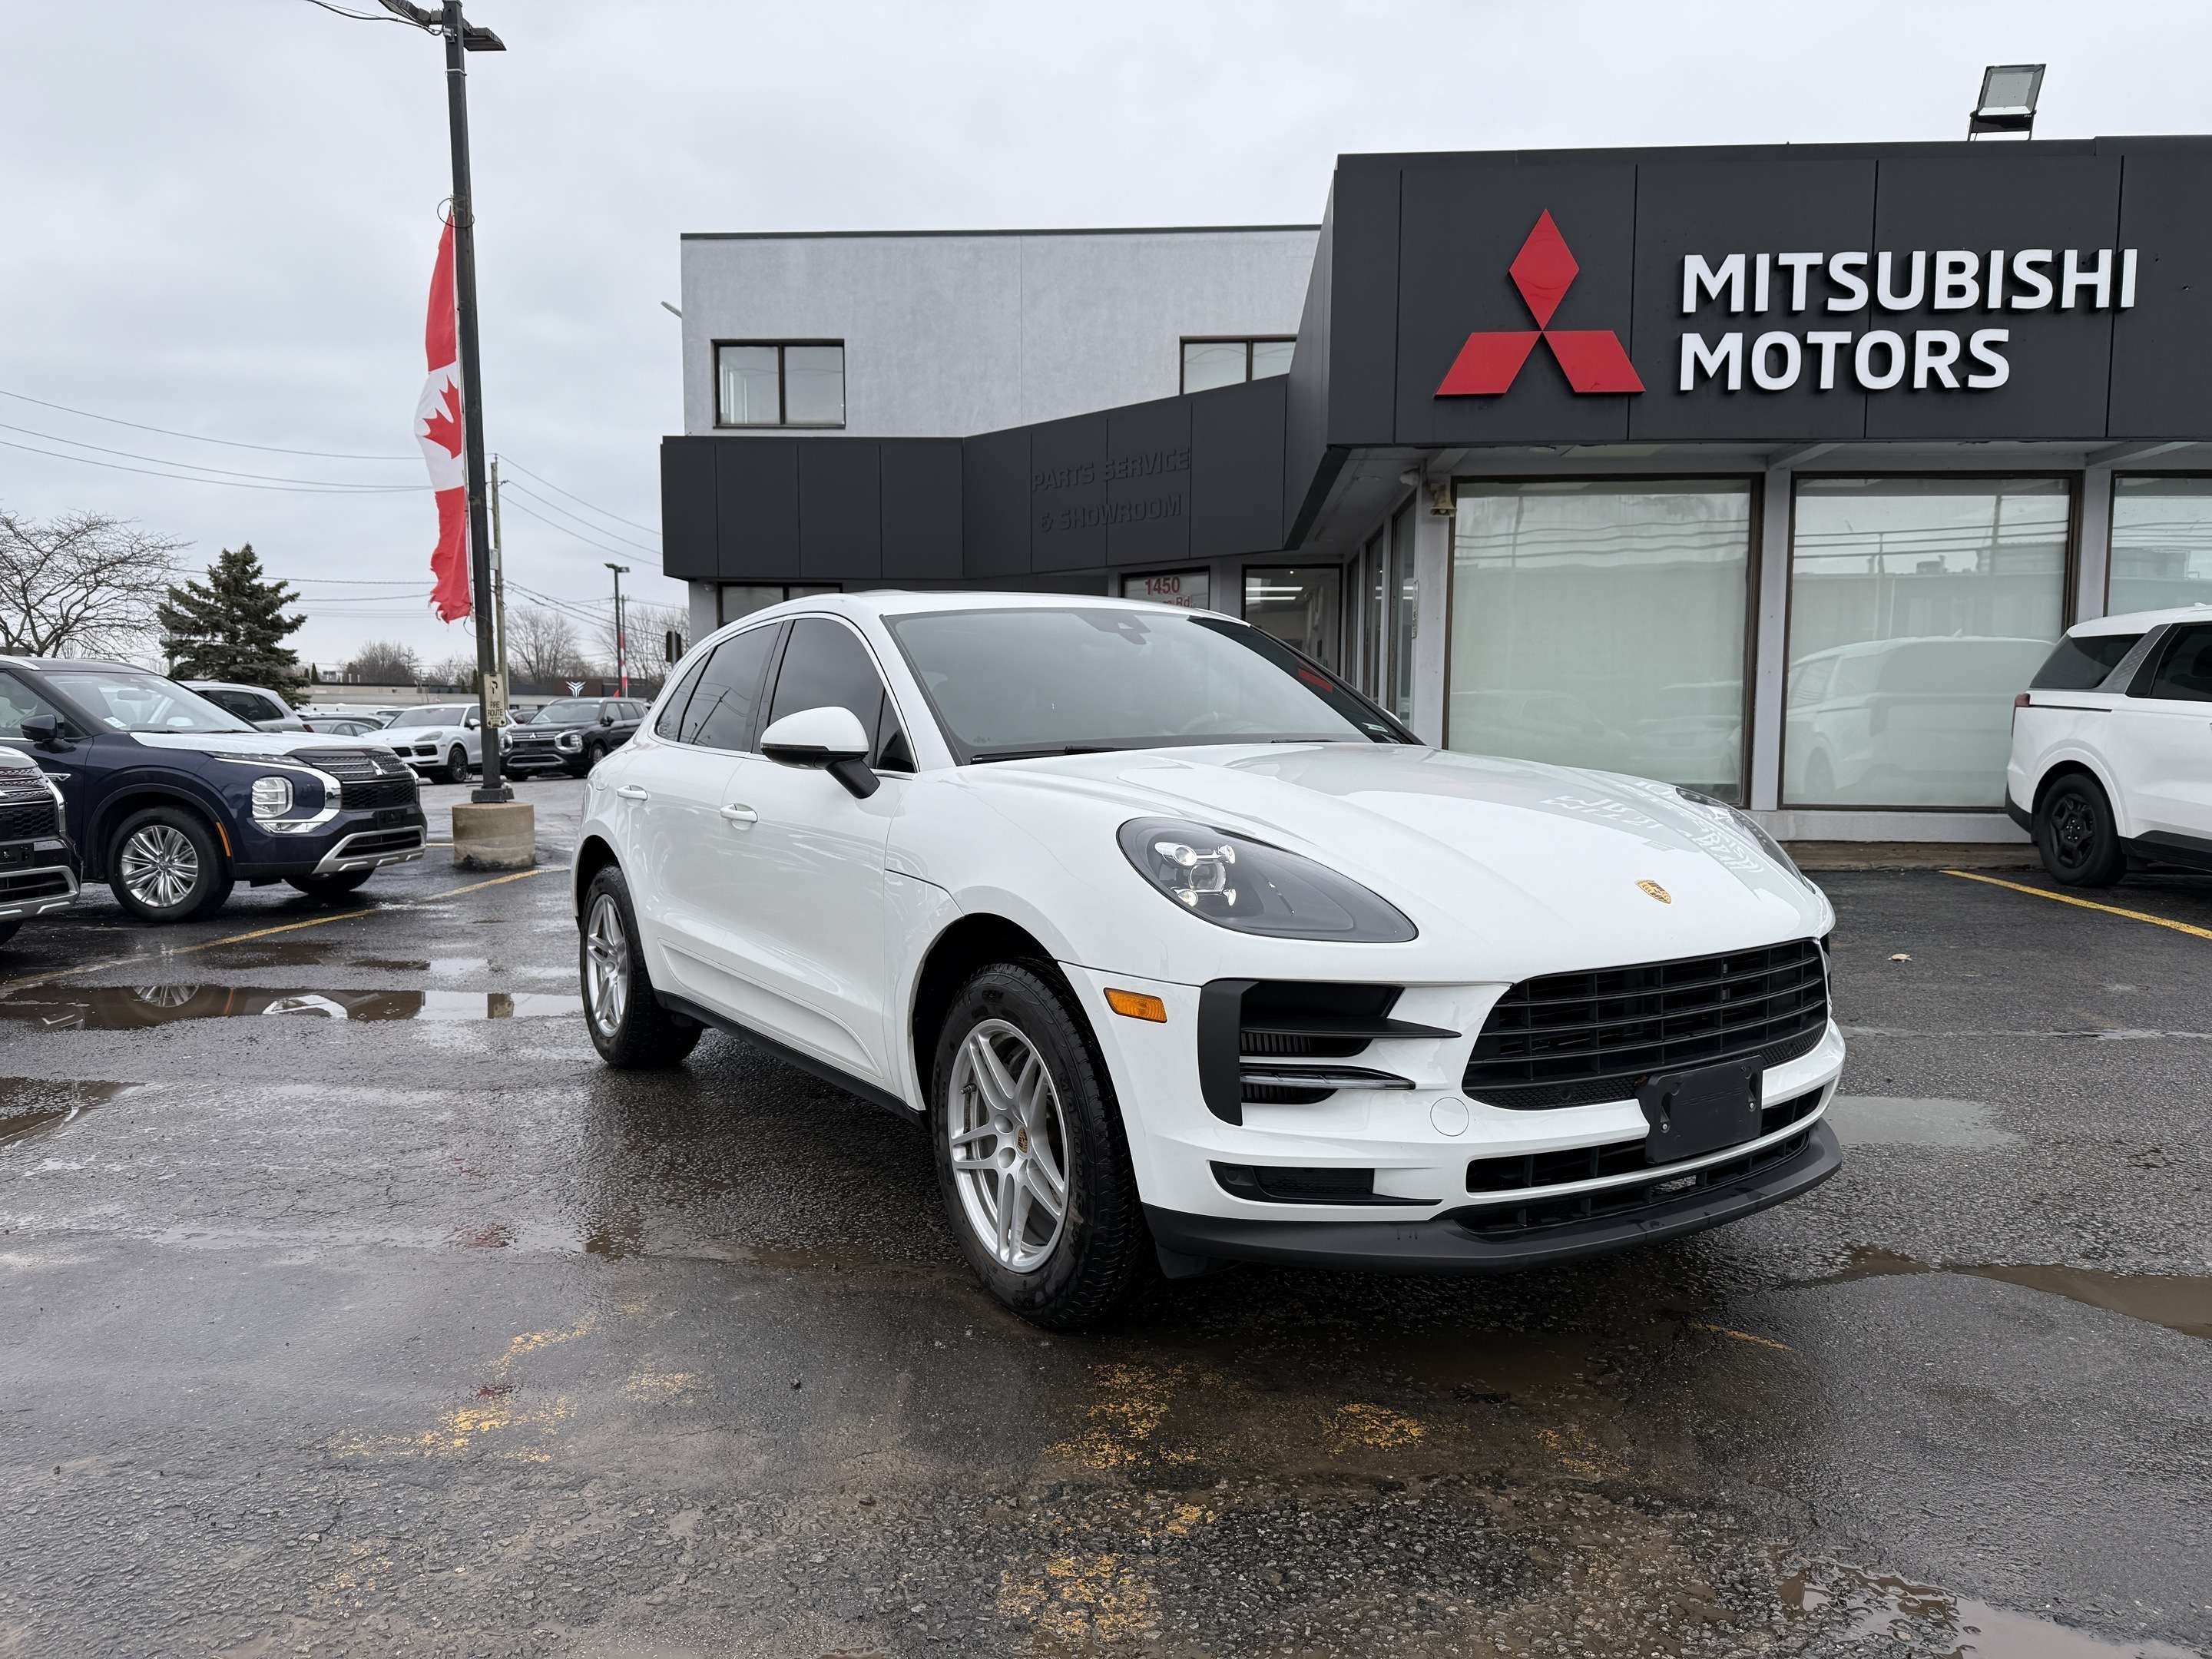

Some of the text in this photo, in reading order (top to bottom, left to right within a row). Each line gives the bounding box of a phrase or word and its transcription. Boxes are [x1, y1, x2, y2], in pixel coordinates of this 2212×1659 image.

[1682, 248, 2138, 313] MITSUBISHI
[1679, 328, 2010, 392] MOTORS
[1032, 446, 1190, 492] PARTS SERVICE
[1058, 493, 1182, 531] SHOWROOM
[1145, 576, 1180, 595] 1450
[487, 708, 503, 717] ROUTE
